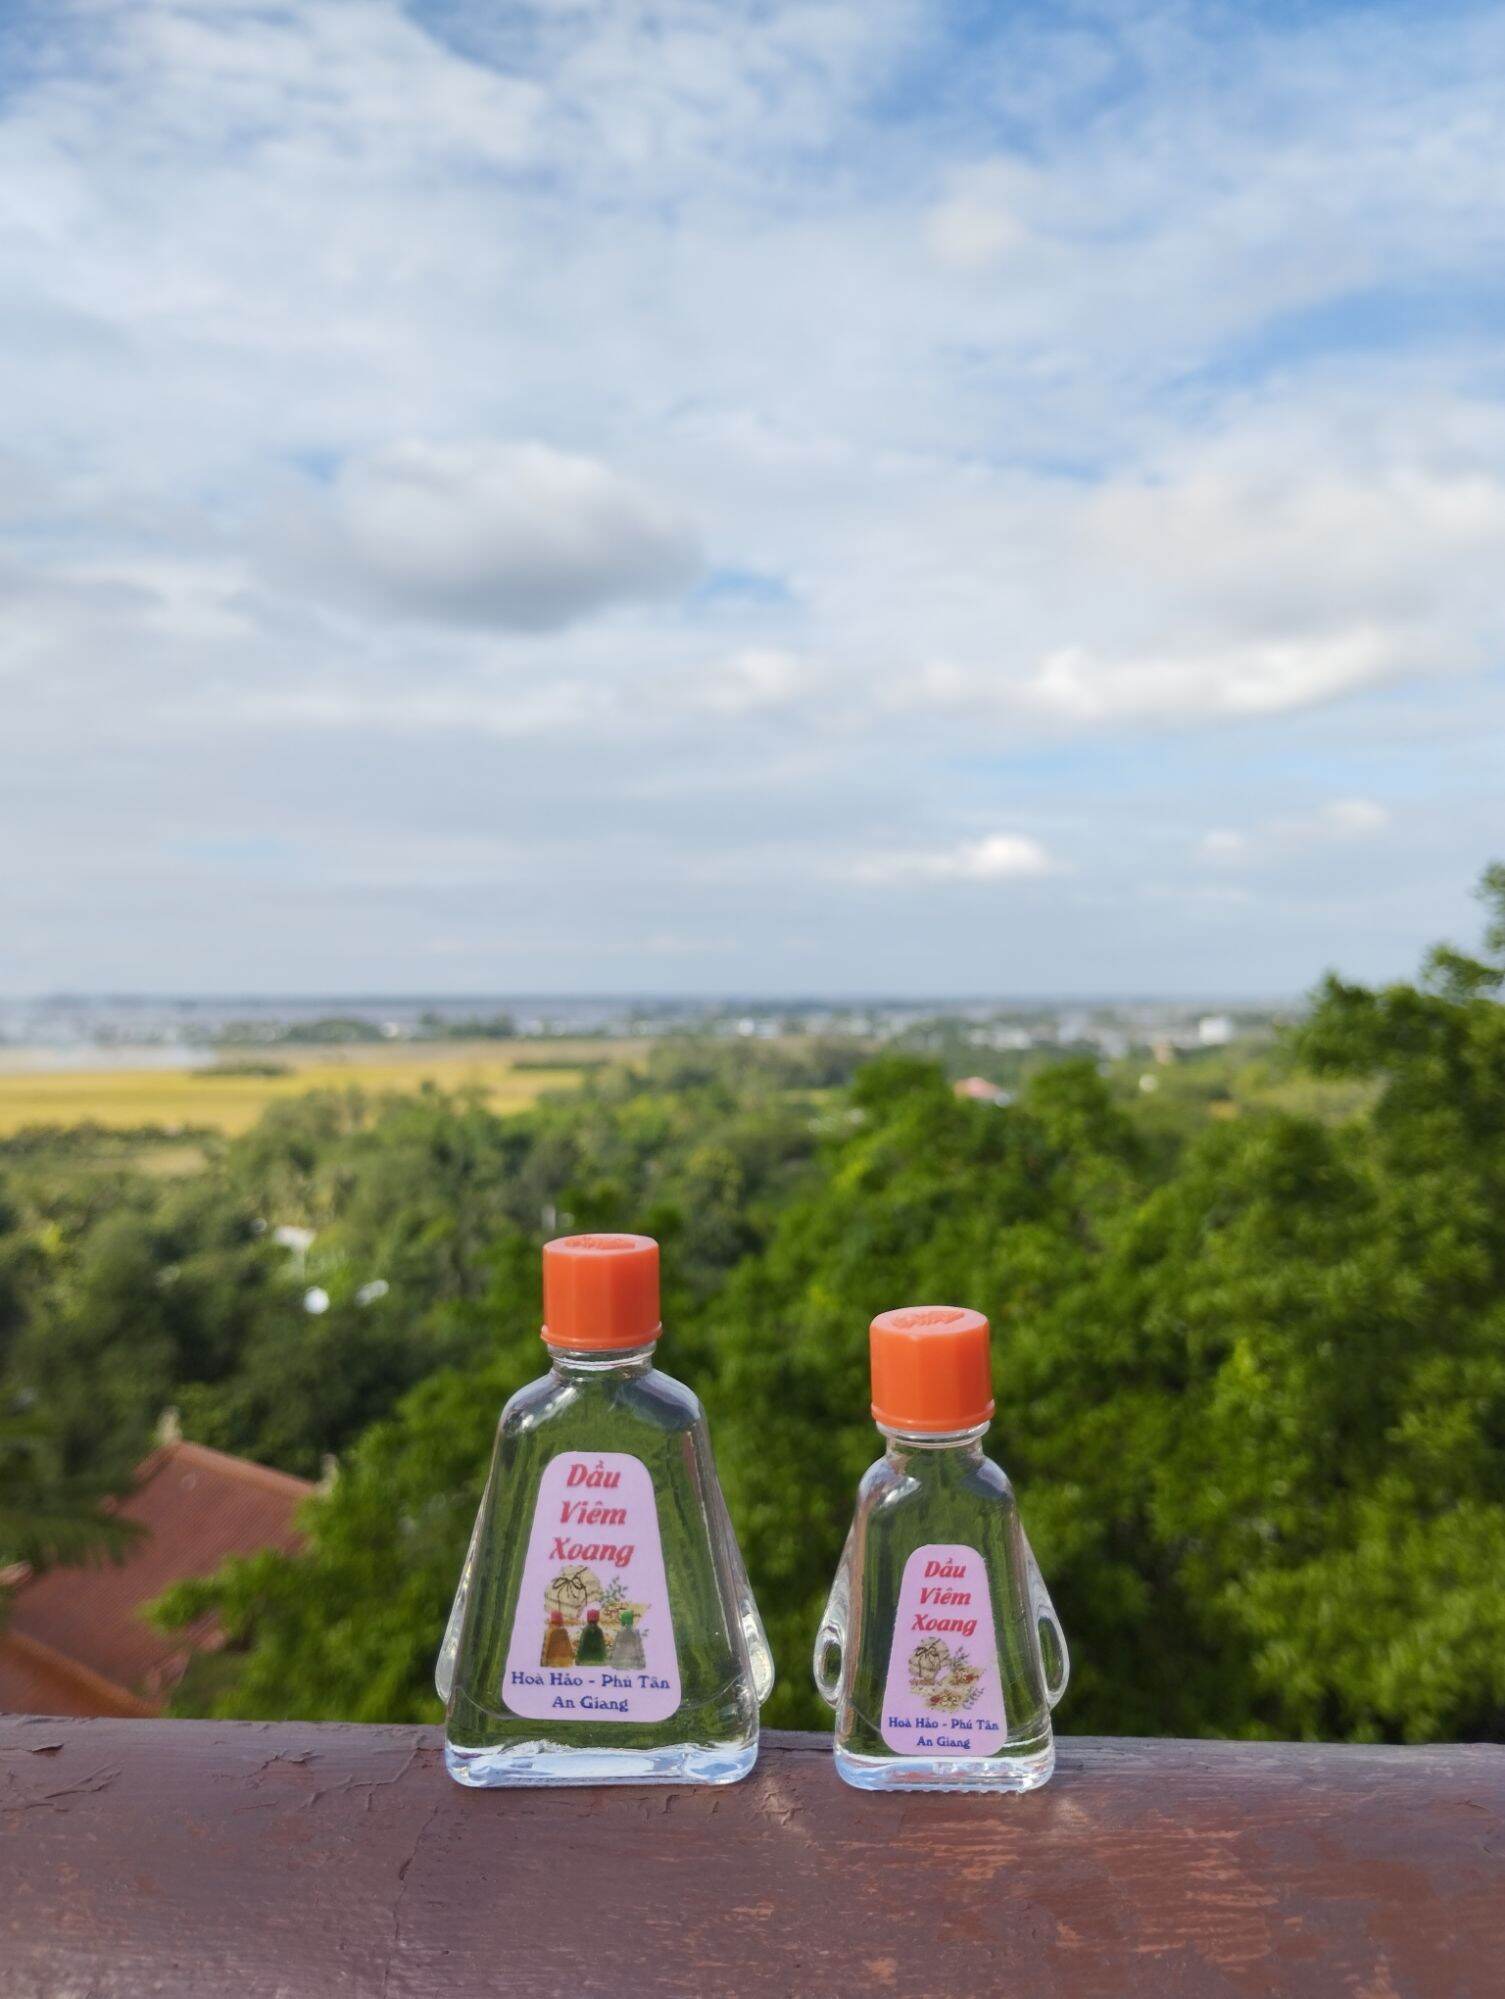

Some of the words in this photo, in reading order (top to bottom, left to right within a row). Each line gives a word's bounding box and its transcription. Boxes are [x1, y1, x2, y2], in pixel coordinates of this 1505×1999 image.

[560, 1500, 627, 1525] Viêm
[549, 1537, 635, 1568] Xoang
[920, 1587, 971, 1605] Viêm
[911, 1613, 977, 1637] Xoang
[552, 1696, 576, 1709] An
[580, 1696, 629, 1712] Giang
[951, 1719, 973, 1730] Phú
[917, 1736, 933, 1747] An
[936, 1737, 971, 1750] Giang
